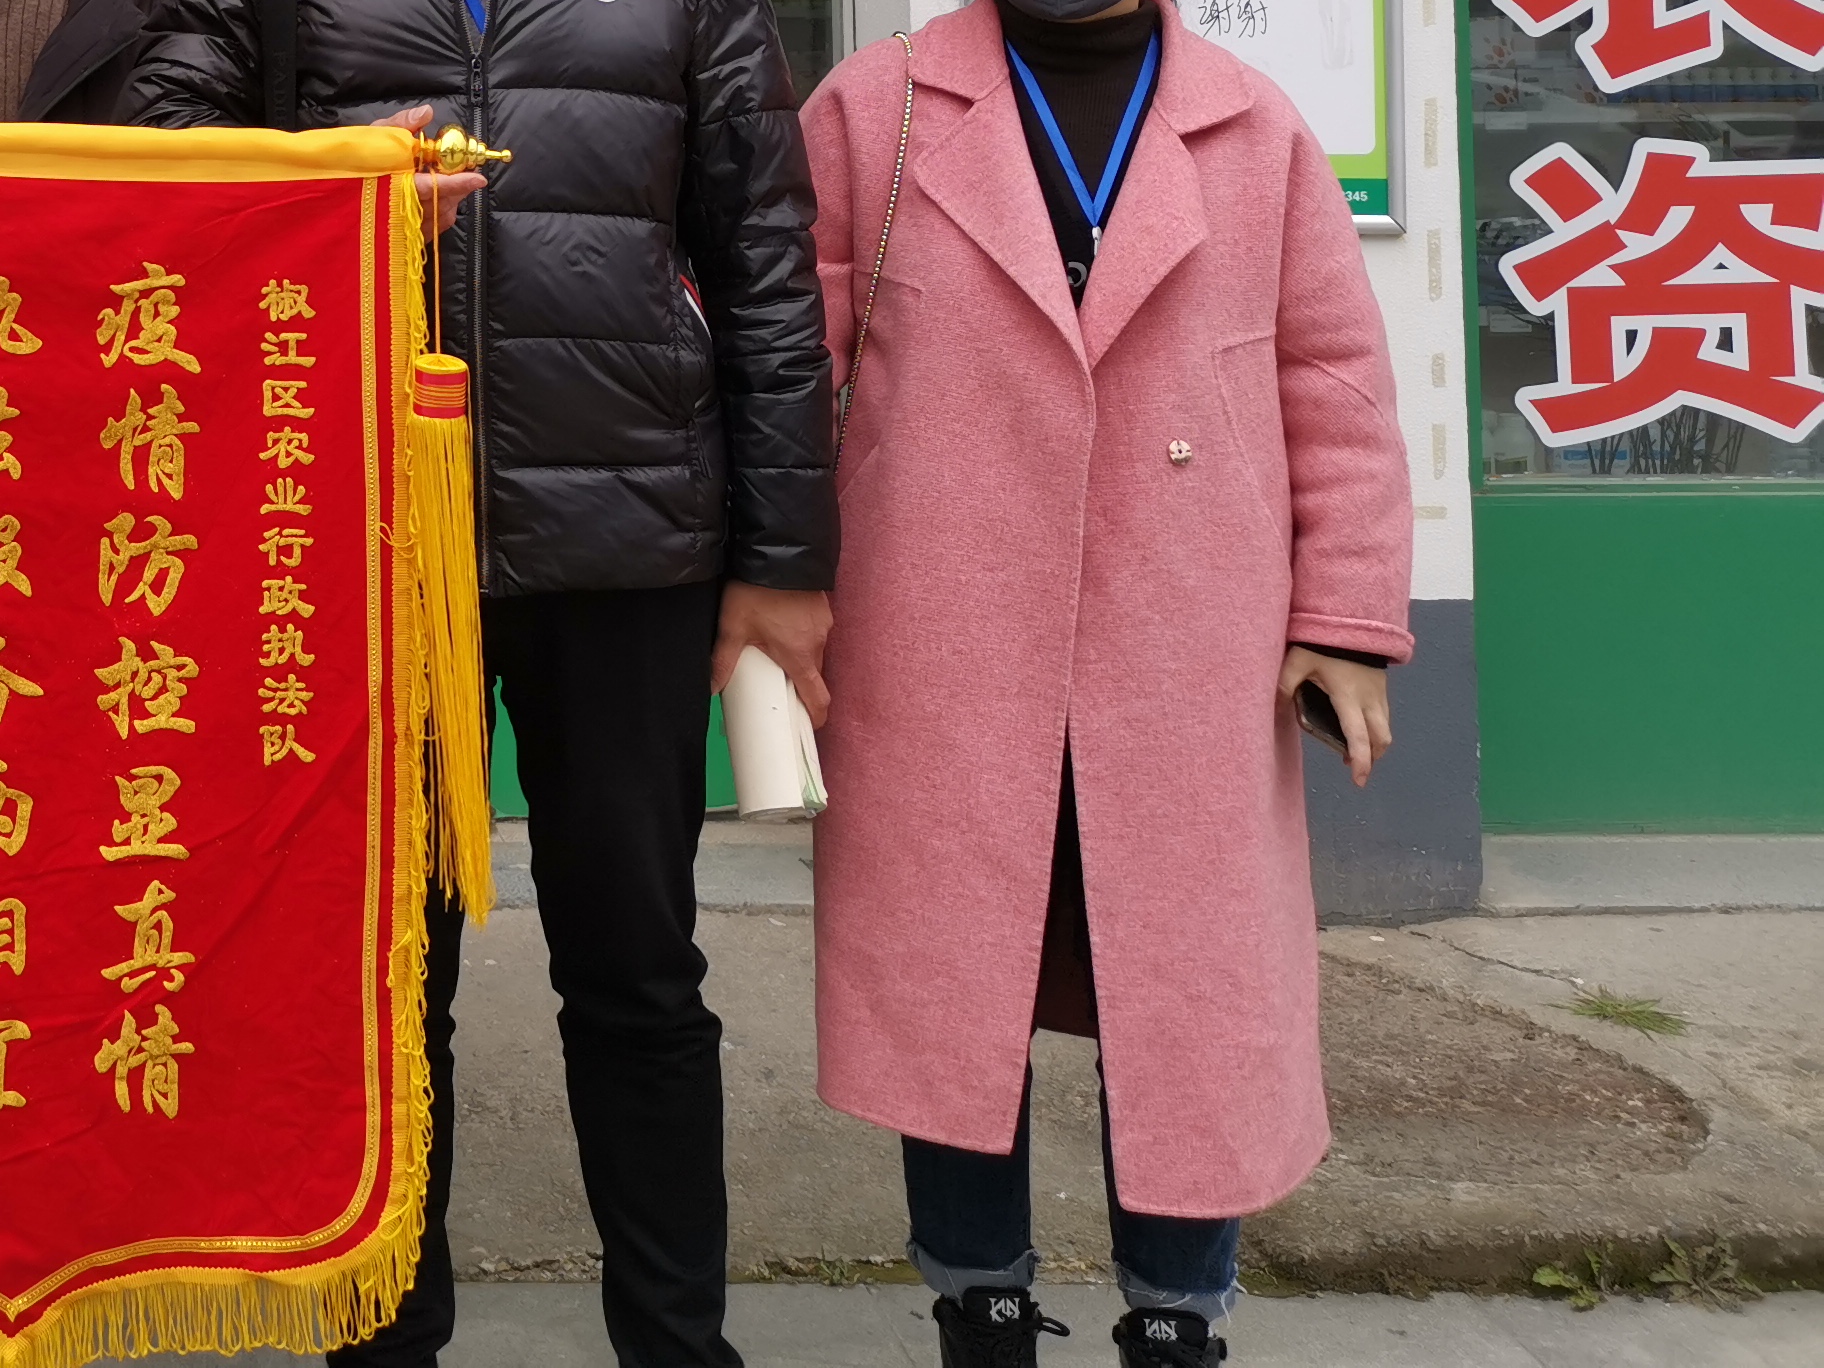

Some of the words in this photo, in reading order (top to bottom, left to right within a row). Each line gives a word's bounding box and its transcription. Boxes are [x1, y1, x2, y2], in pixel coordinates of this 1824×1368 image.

[1343, 190, 1369, 202] 345
[93, 261, 203, 1121] 疫情防控显真情
[258, 278, 317, 767] 椒江区农业行政执法队
